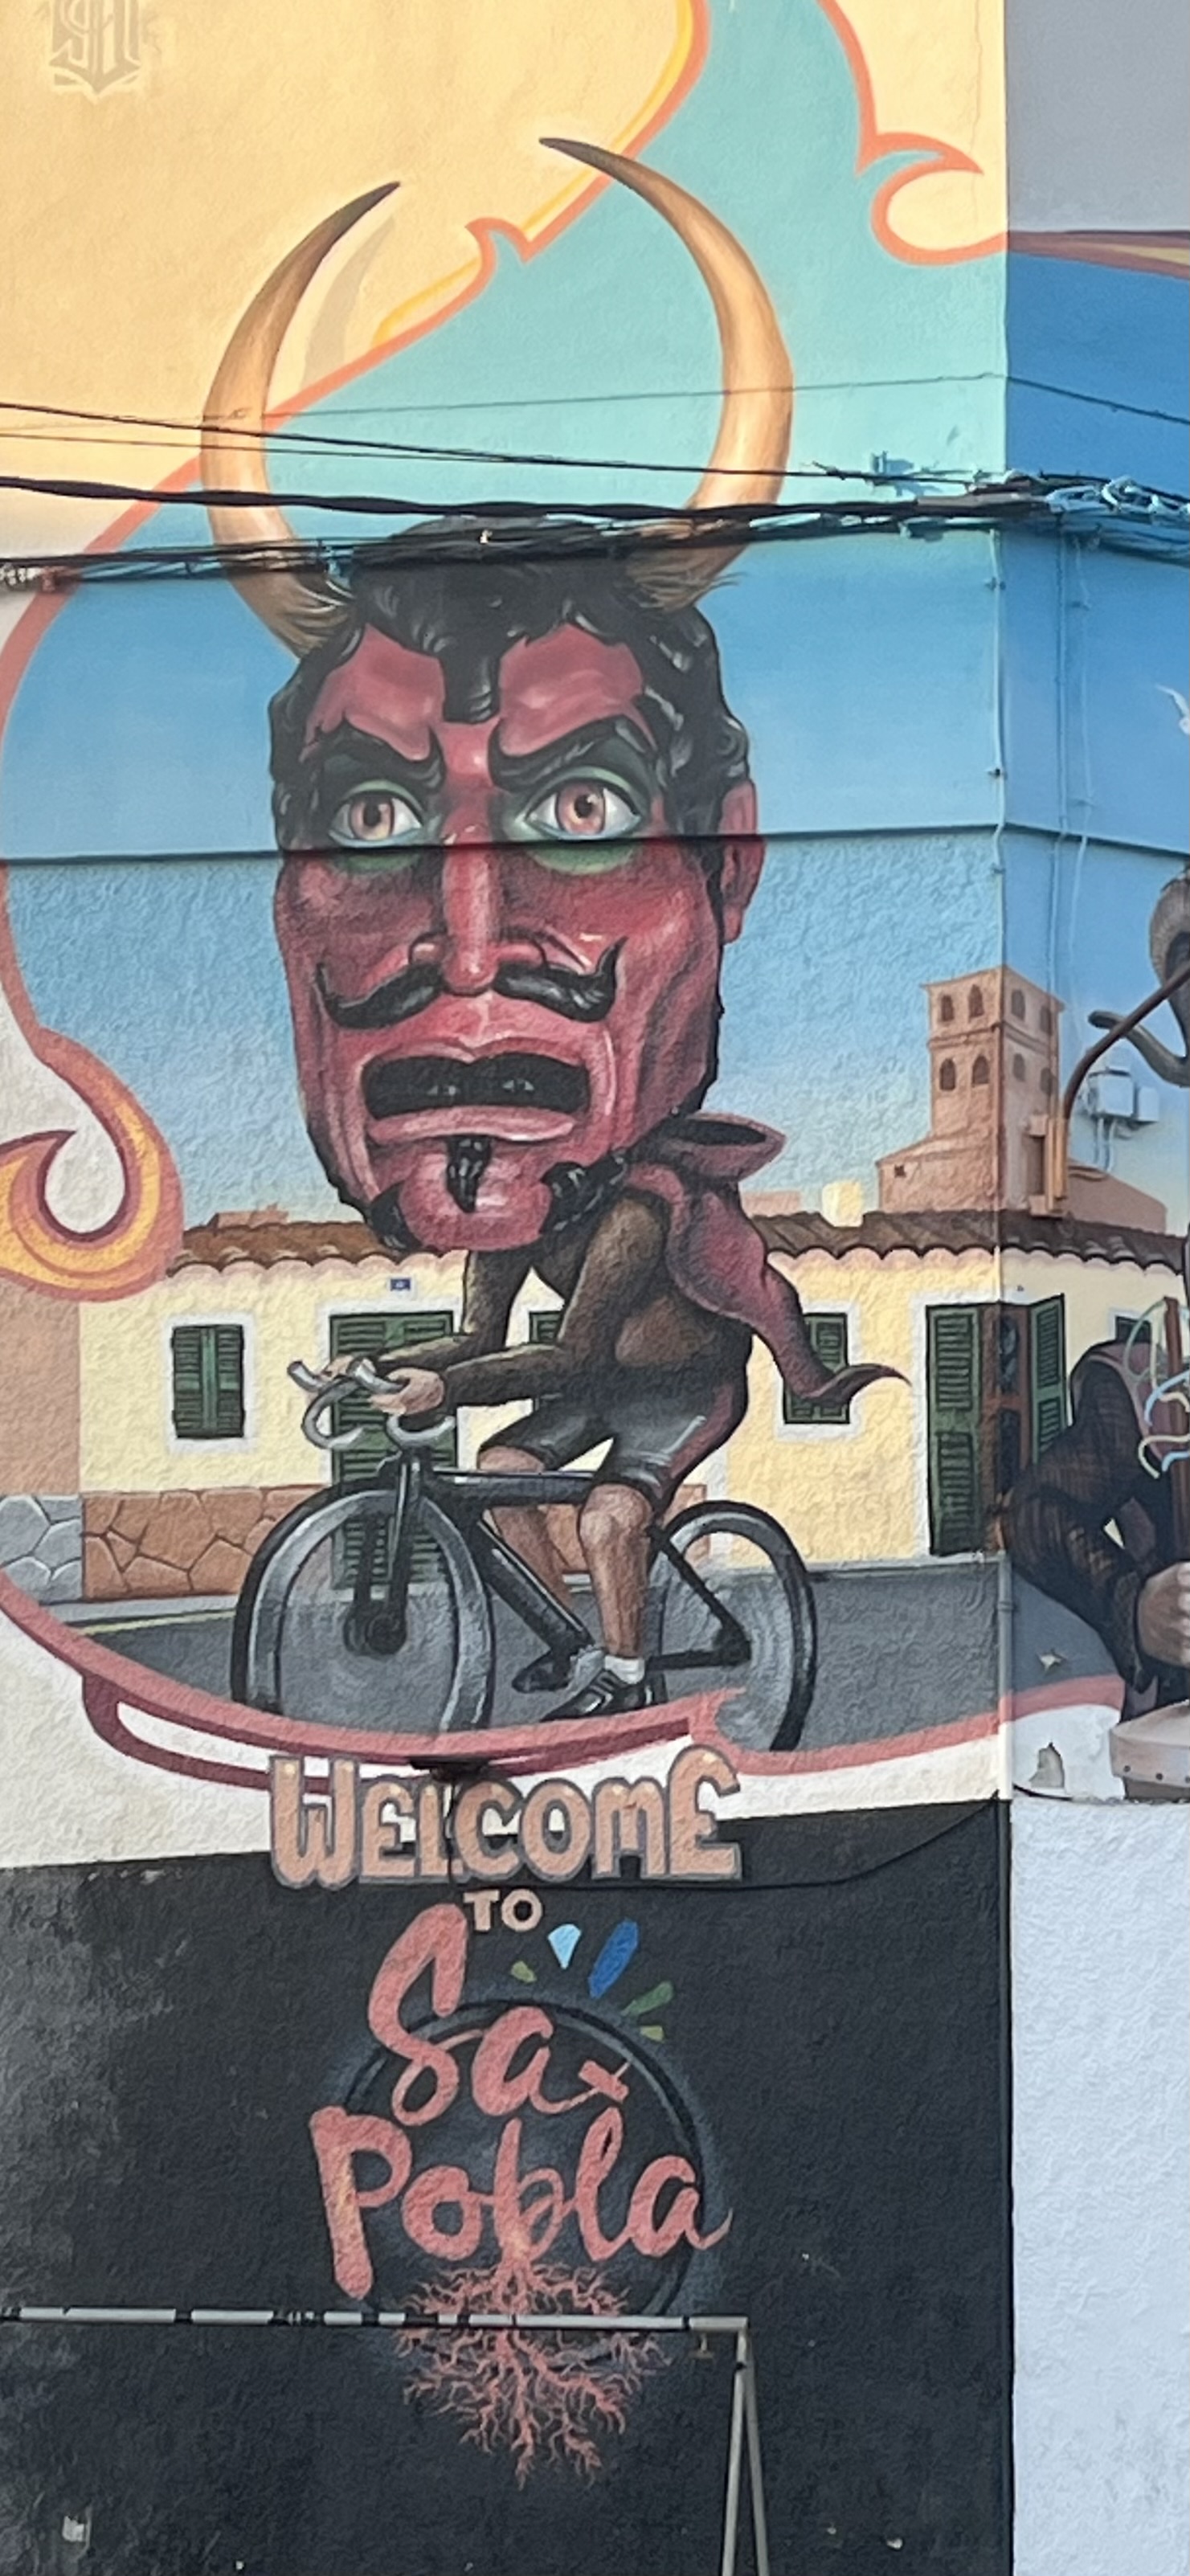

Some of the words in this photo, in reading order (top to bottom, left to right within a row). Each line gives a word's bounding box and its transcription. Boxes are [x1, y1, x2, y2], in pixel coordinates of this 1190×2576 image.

[269, 1744, 742, 1890] WELCOME
[464, 1889, 543, 1932] TO
[367, 1903, 630, 2126] Sa
[310, 2107, 733, 2300] Pobla
